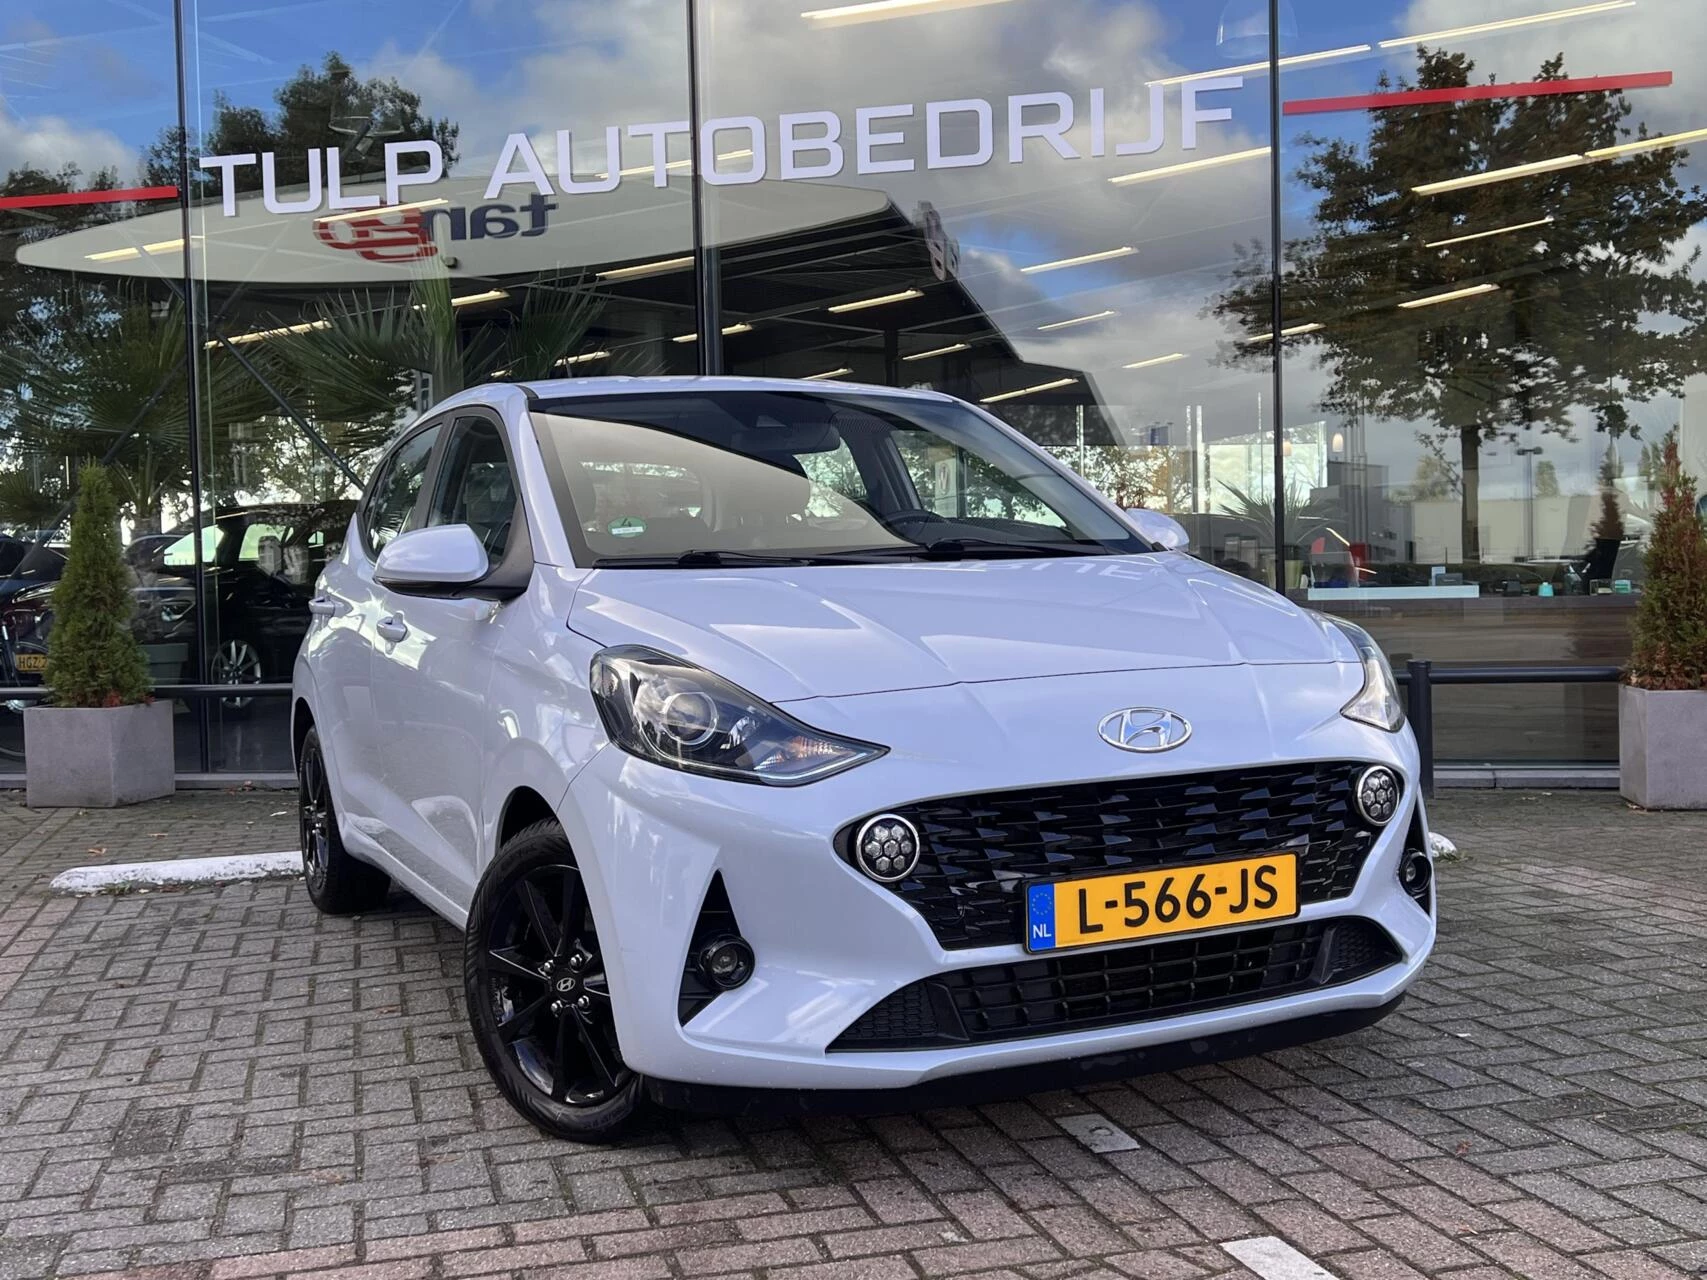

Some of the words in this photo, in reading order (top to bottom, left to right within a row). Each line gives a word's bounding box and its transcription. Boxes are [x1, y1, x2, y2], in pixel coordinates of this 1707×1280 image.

[199, 140, 445, 217] TULP
[485, 76, 1243, 199] AUTOBEDRIJF
[1032, 924, 1052, 939] NL
[1078, 865, 1278, 934] L-566-JS
